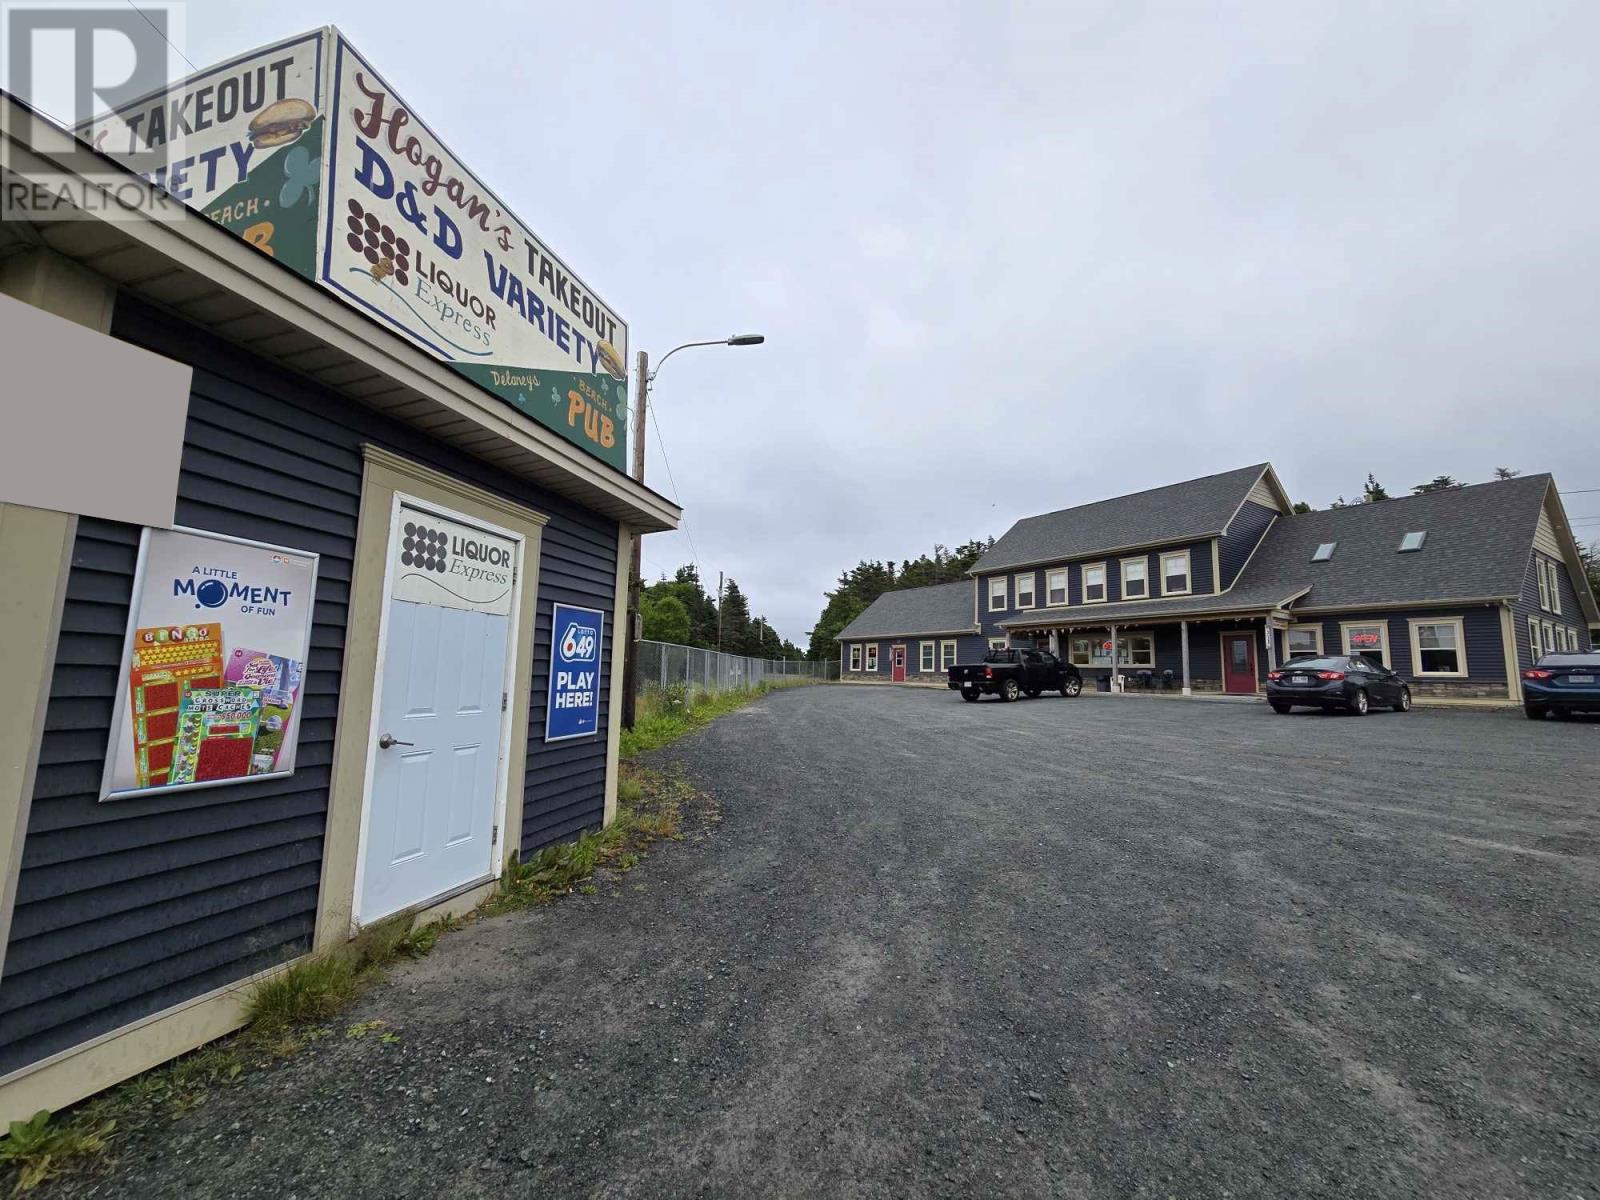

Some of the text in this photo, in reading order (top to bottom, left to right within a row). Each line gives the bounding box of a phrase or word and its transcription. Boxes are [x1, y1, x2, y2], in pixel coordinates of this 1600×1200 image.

[126, 57, 294, 155] TAKEOUT
[138, 140, 255, 201] IETY
[205, 197, 259, 224] EACH
[354, 72, 617, 346] Hogan's TAKEOUT
[354, 136, 599, 376] D&D VARIETY
[415, 251, 497, 331] LIQUOR
[414, 276, 491, 347] Express
[490, 371, 541, 391] Delaneys
[567, 390, 615, 448] PUB
[452, 535, 511, 569] LIQUOR
[191, 566, 238, 580] A LITTLE
[449, 558, 508, 585] Express
[240, 605, 276, 616] OF FUN
[143, 626, 208, 643] BINGO
[557, 672, 594, 690] PLAY
[556, 692, 593, 709] HERE!
